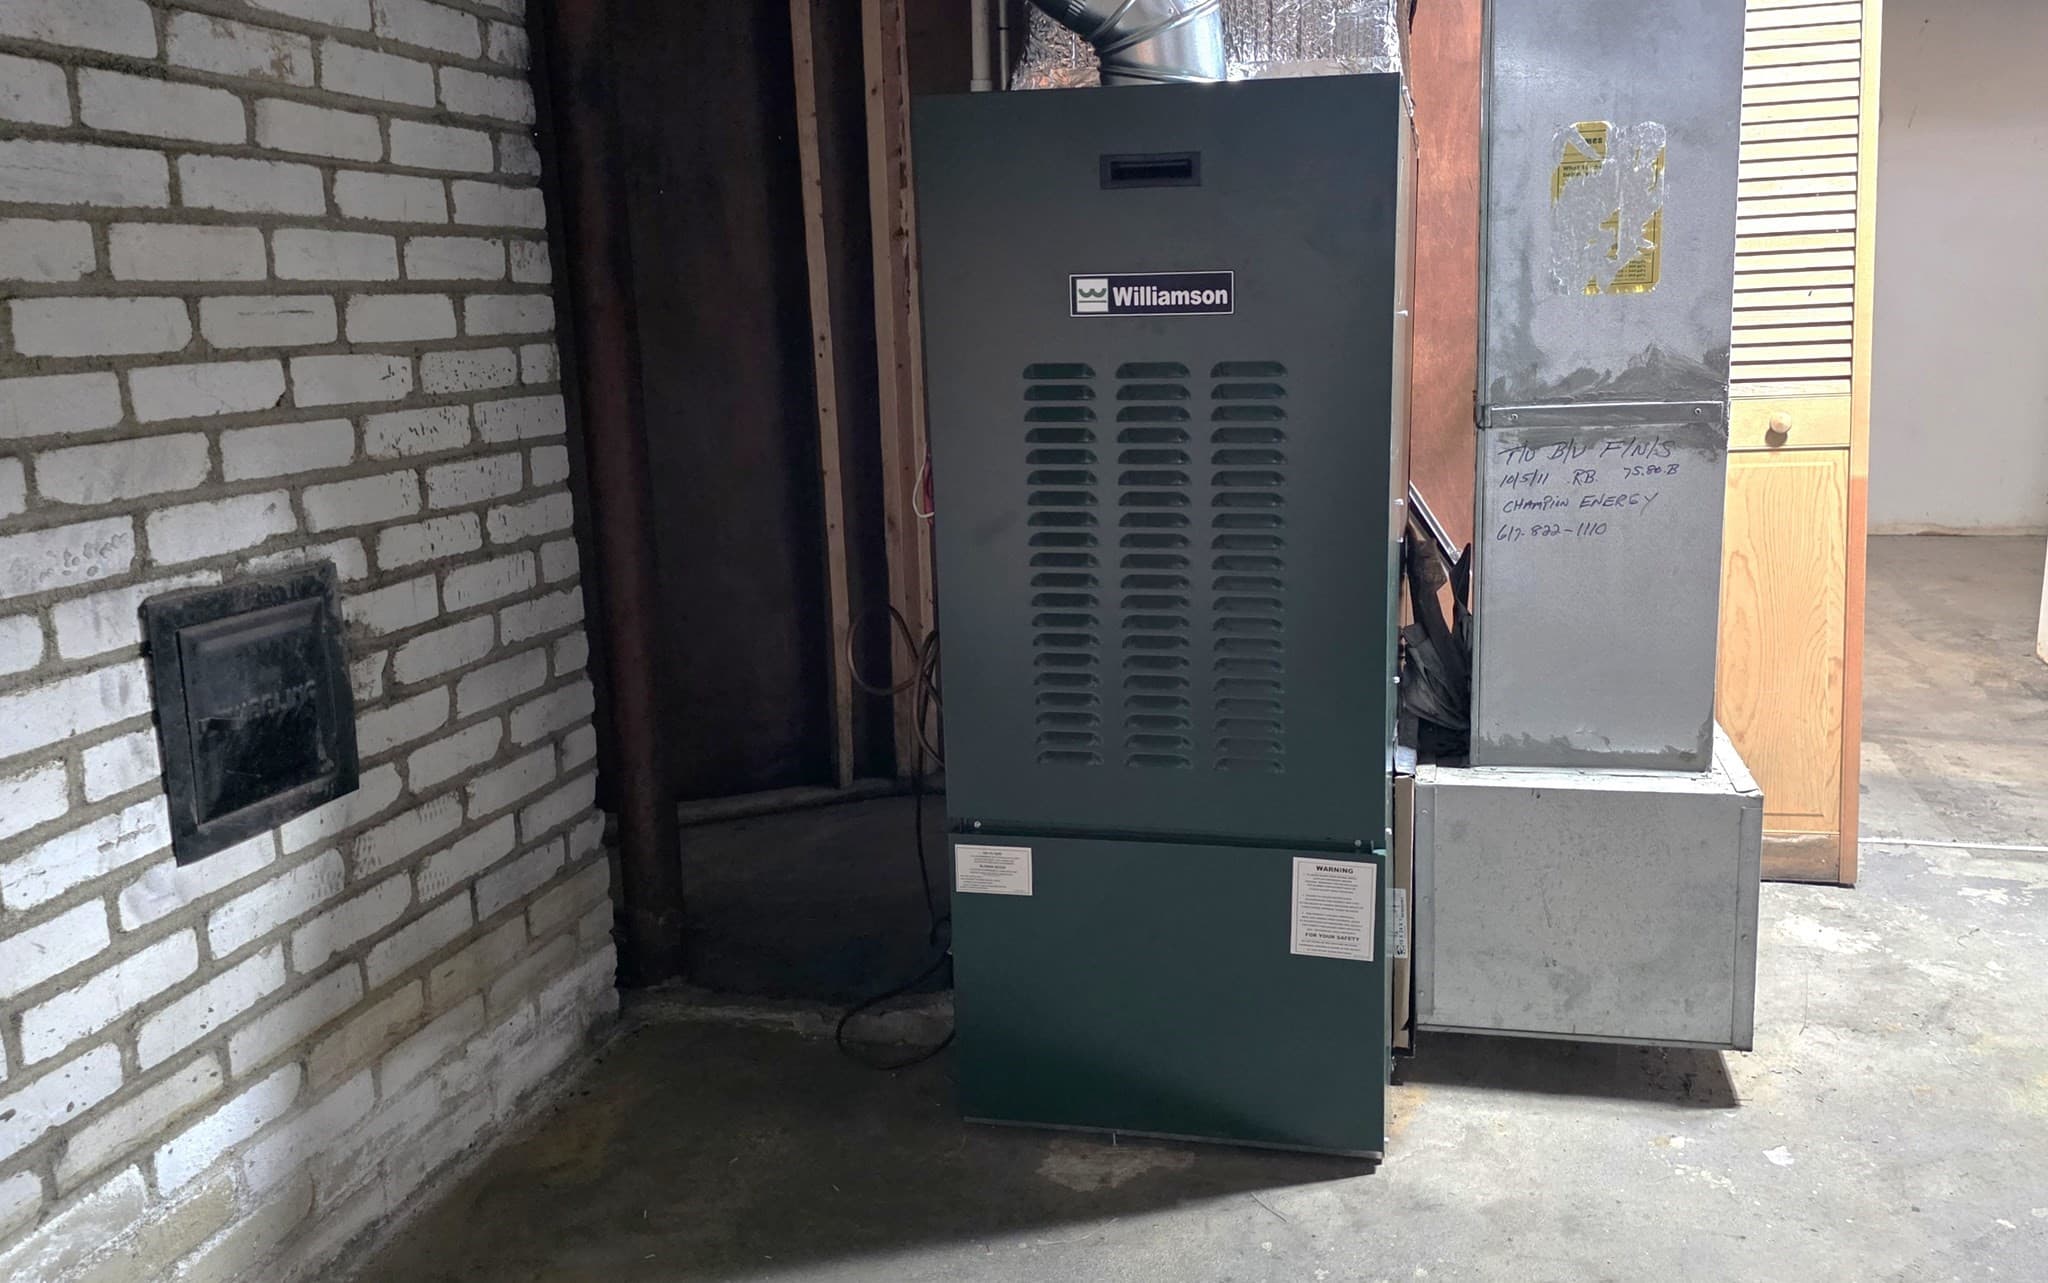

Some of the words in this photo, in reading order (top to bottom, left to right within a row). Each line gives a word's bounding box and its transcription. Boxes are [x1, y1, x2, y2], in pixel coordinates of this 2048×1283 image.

[1112, 286, 1228, 307] Williamson
[1500, 469, 1549, 489] 10/5/11
[1579, 493, 1659, 516] ENERGY
[1316, 865, 1354, 874] WARNING
